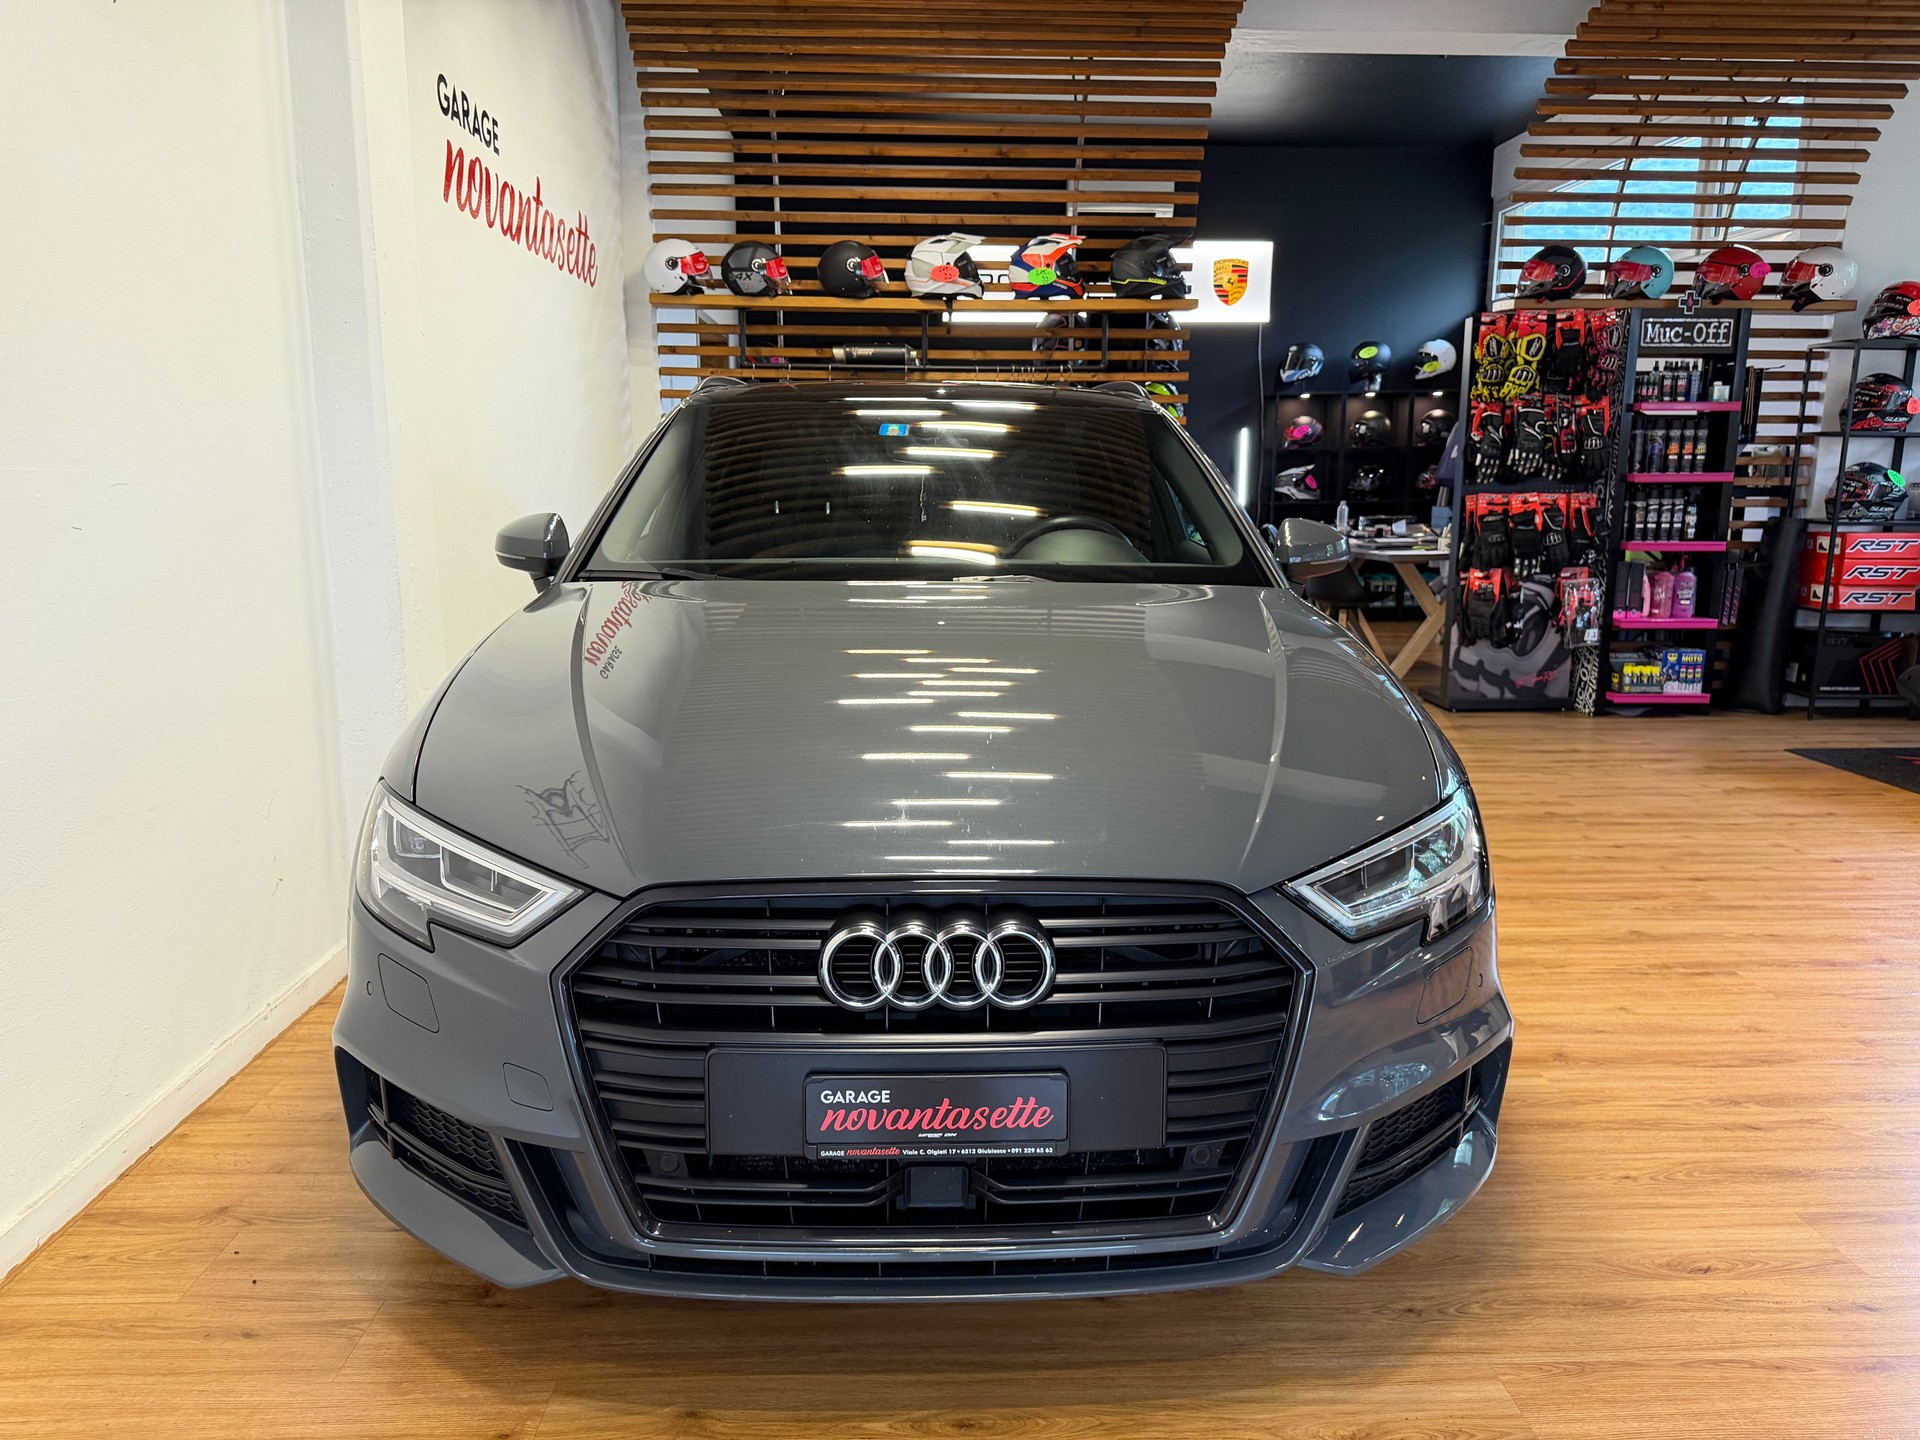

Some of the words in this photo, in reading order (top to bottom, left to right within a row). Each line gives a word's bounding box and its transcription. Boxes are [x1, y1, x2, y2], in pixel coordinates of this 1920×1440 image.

[437, 73, 500, 156] GARAGE
[443, 138, 598, 288] novantasette
[1645, 323, 1729, 343] Muc-Off
[1846, 539, 1920, 553] RST
[1843, 565, 1919, 580] RST
[1839, 591, 1915, 605] RST
[820, 1090, 891, 1104] GARAGE
[820, 1096, 1054, 1132] novantasette
[846, 1146, 900, 1155] novantasette
